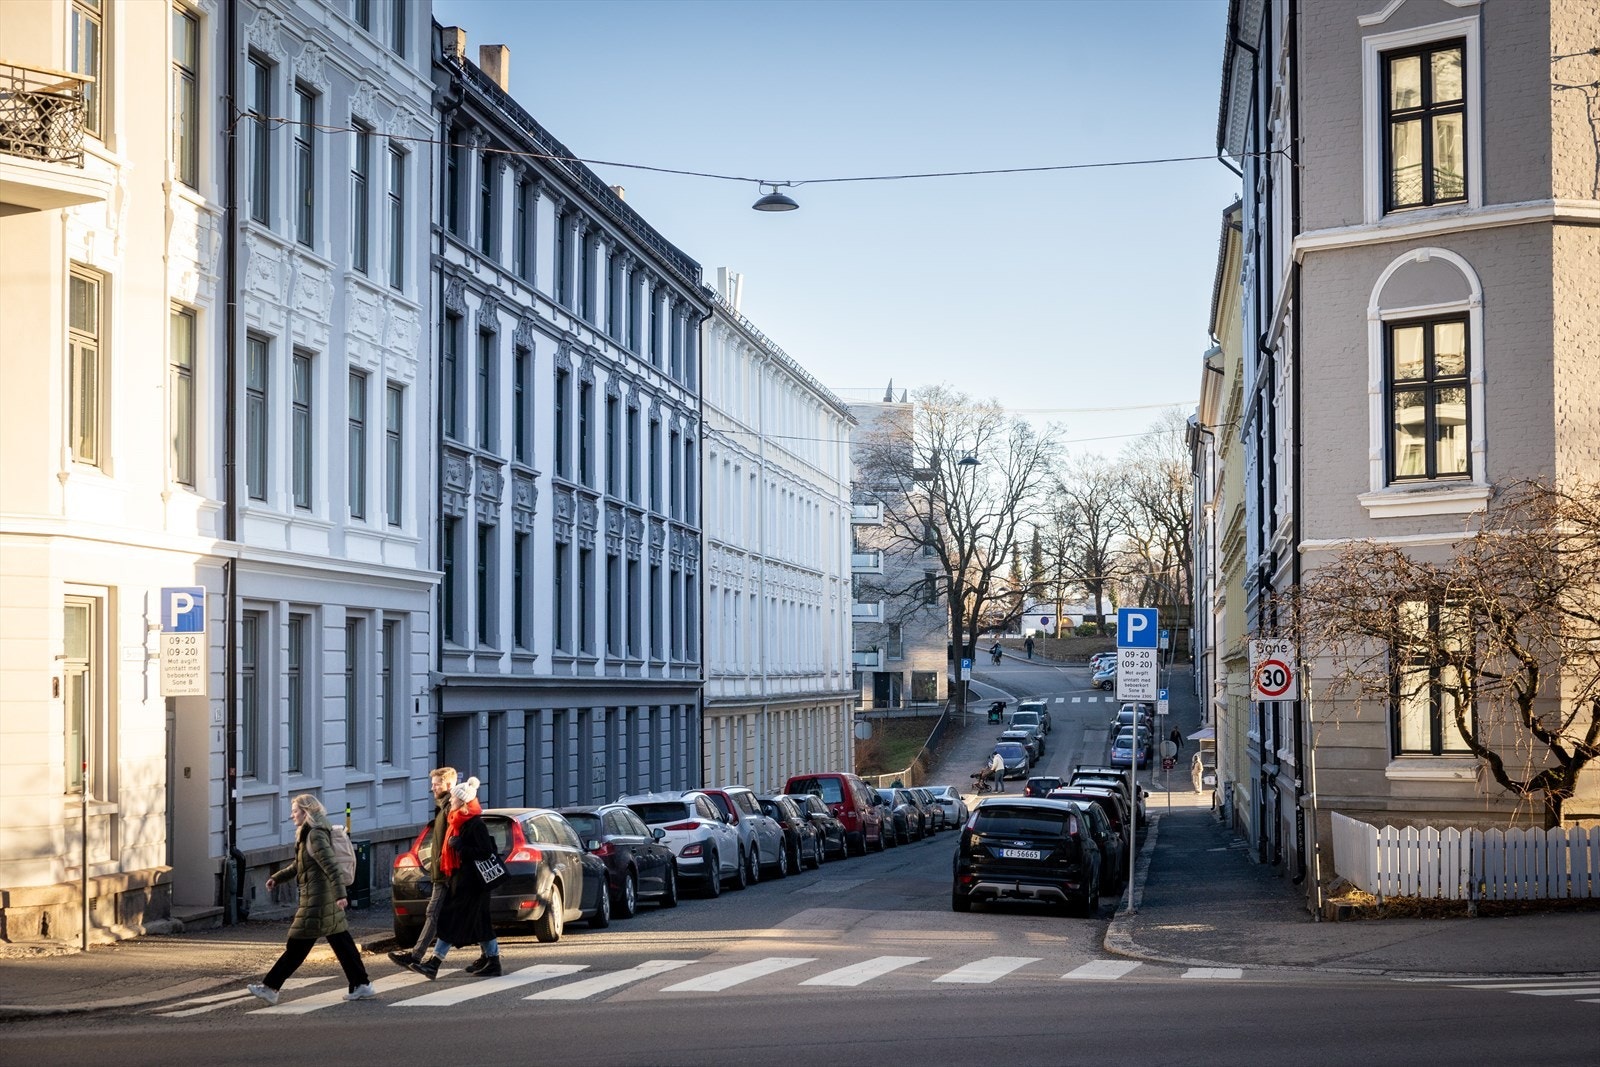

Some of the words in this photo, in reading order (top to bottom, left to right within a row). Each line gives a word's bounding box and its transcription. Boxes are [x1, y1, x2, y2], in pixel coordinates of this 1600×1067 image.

[171, 593, 194, 627] P
[1128, 614, 1148, 642] P
[1262, 669, 1285, 687] 30
